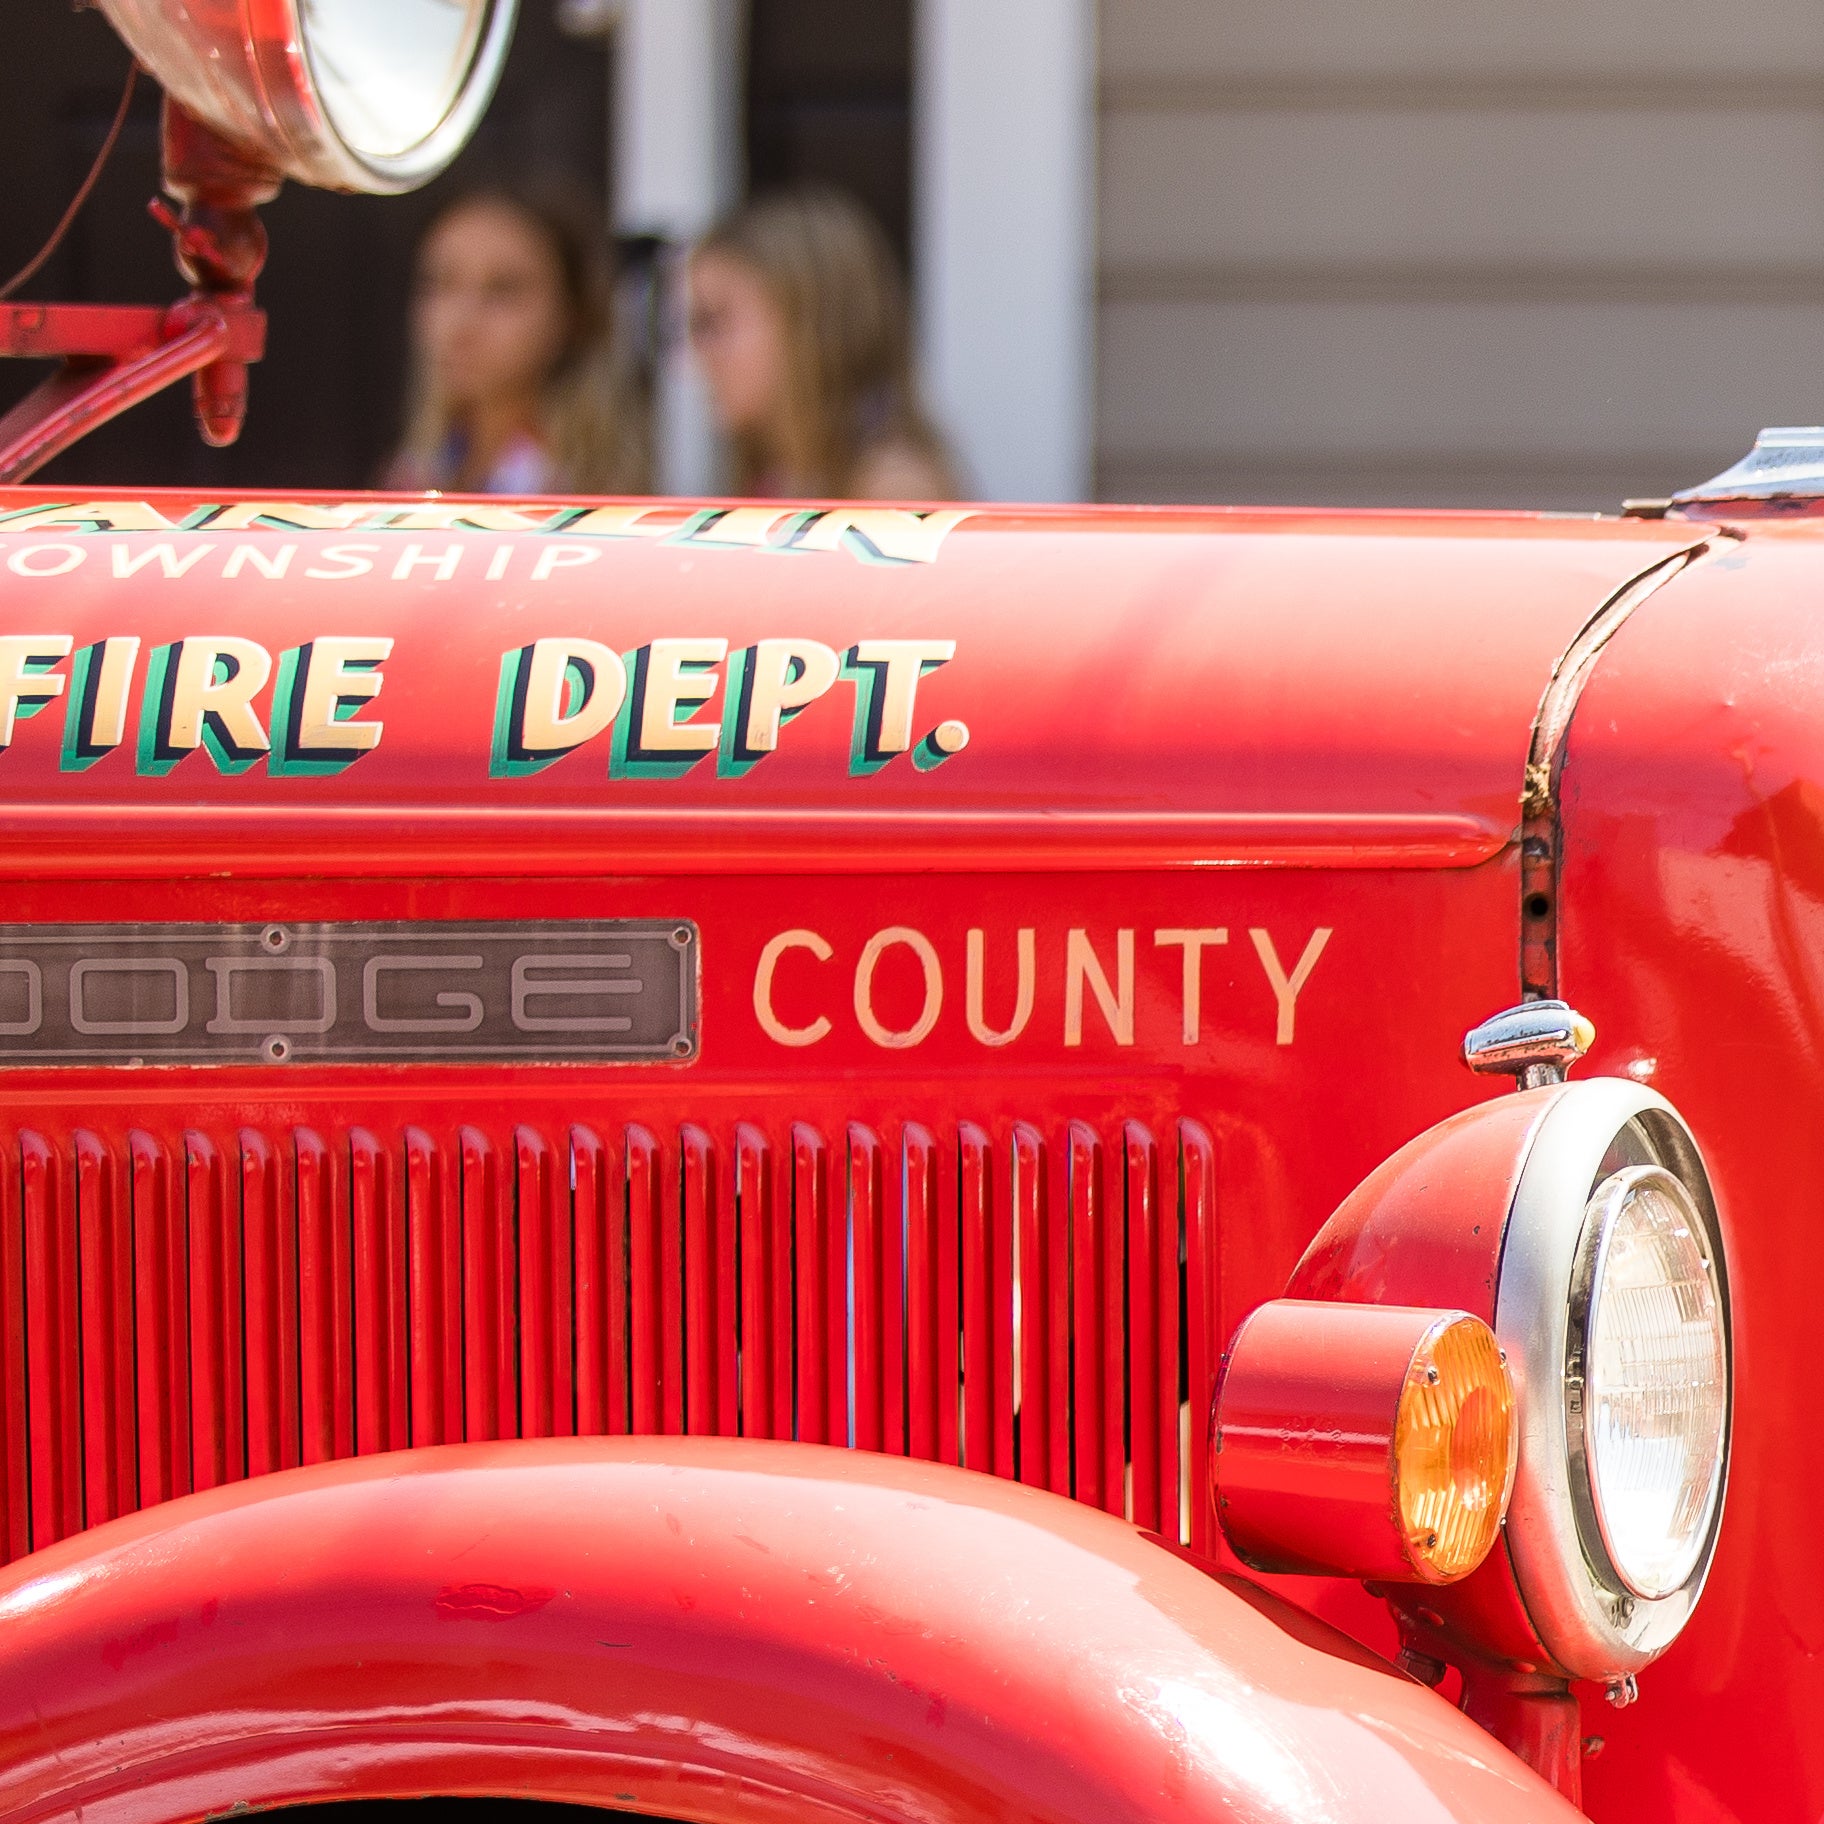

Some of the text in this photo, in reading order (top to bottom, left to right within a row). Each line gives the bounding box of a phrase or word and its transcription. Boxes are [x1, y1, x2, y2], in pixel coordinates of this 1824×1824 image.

[0, 501, 985, 565] ANKLIN
[0, 542, 603, 581] OWNSHIP
[0, 634, 970, 779] FIRE DEPT.
[753, 926, 1333, 1048] COUNTY
